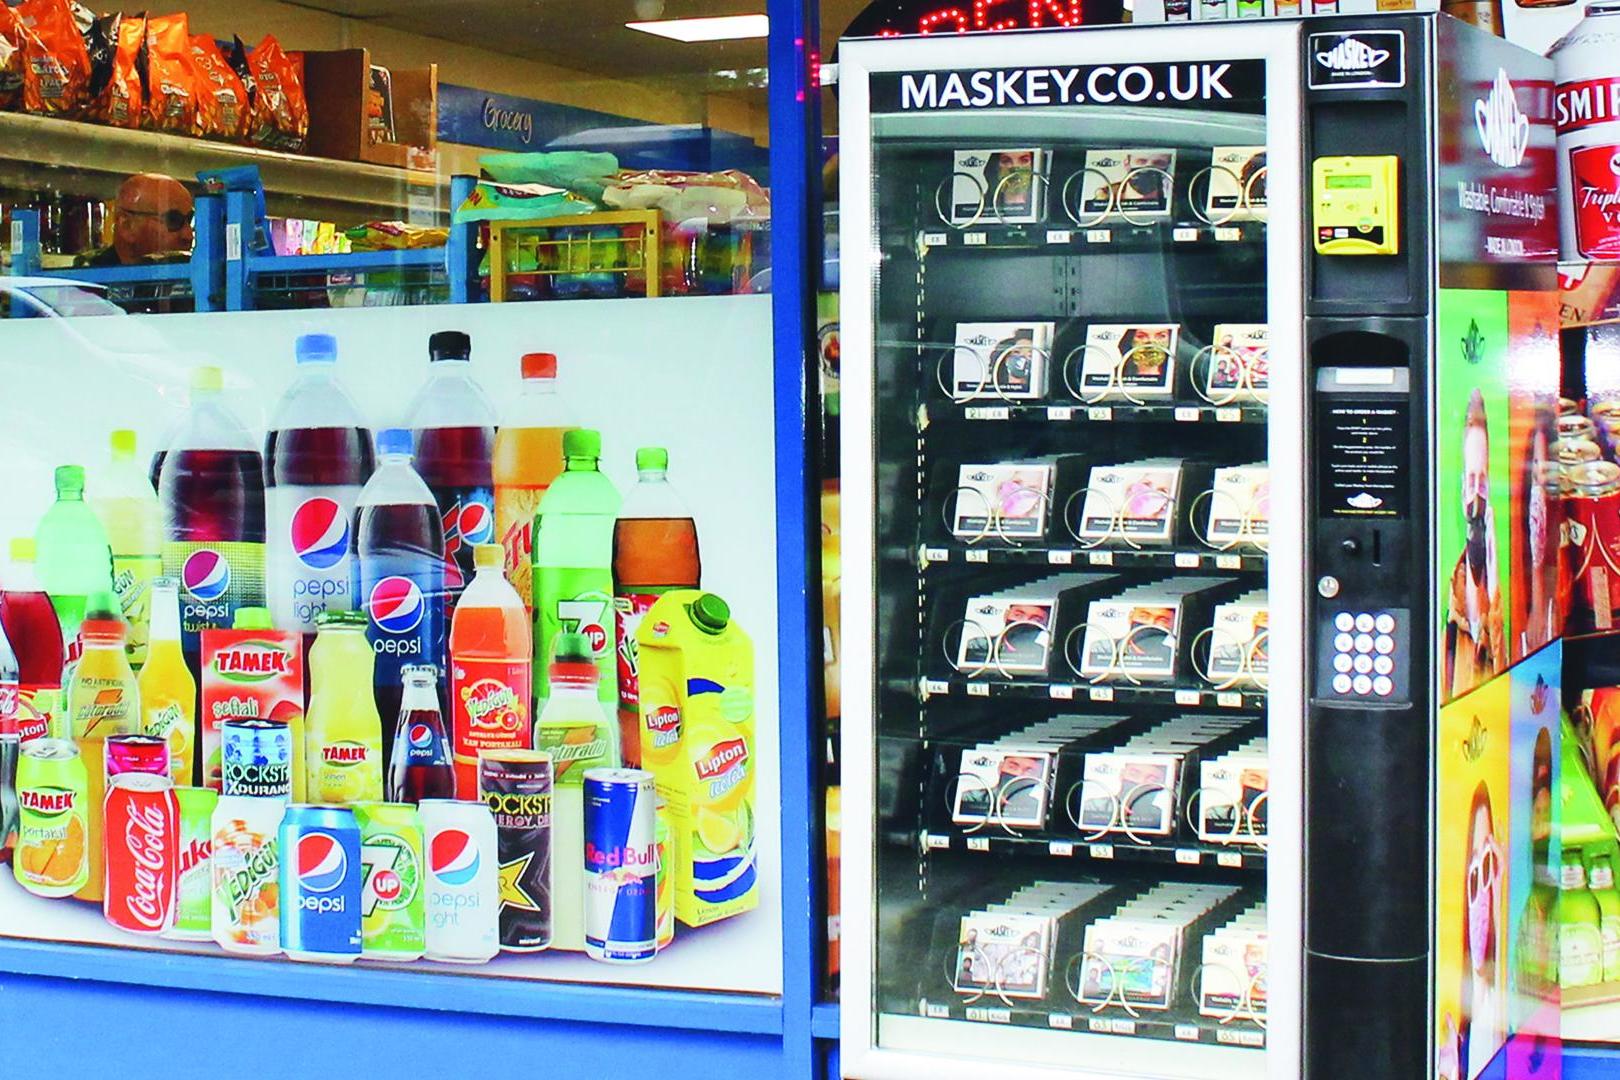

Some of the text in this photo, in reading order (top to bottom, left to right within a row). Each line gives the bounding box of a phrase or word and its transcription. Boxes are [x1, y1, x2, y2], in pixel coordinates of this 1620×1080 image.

[902, 64, 1233, 109] MASKEY.CO.UK
[484, 97, 532, 144] Grocery
[294, 577, 349, 601] pepsi
[184, 602, 229, 624] pepsi
[294, 602, 328, 624] light
[374, 636, 421, 657] pepsi
[216, 650, 287, 673] TAMEK
[647, 711, 678, 730] Lipton
[322, 745, 367, 761] TAMEK
[409, 749, 433, 758] pepsi
[698, 740, 746, 778] Lipton
[21, 791, 73, 810] TAMEK
[587, 843, 655, 868] Red Bull
[376, 877, 400, 894] UP
